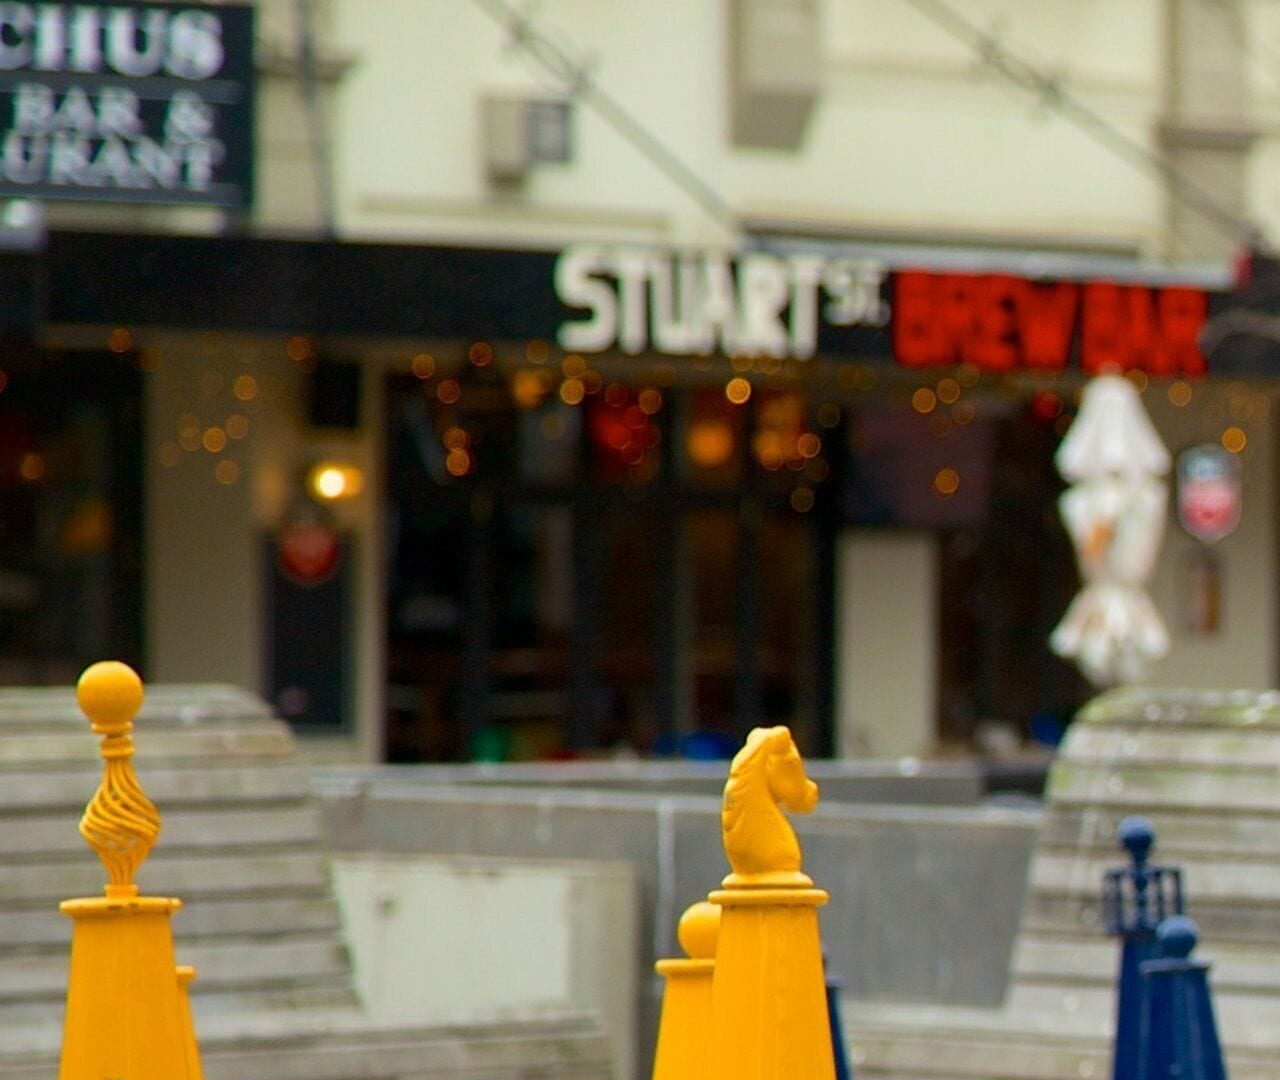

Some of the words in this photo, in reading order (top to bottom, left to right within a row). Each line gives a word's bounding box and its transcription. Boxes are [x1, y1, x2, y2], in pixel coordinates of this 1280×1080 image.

[14, 84, 141, 136] BAR
[165, 90, 214, 143] &
[555, 247, 822, 359] STUART
[893, 271, 1077, 372] BREW
[1081, 280, 1208, 377] BAR
